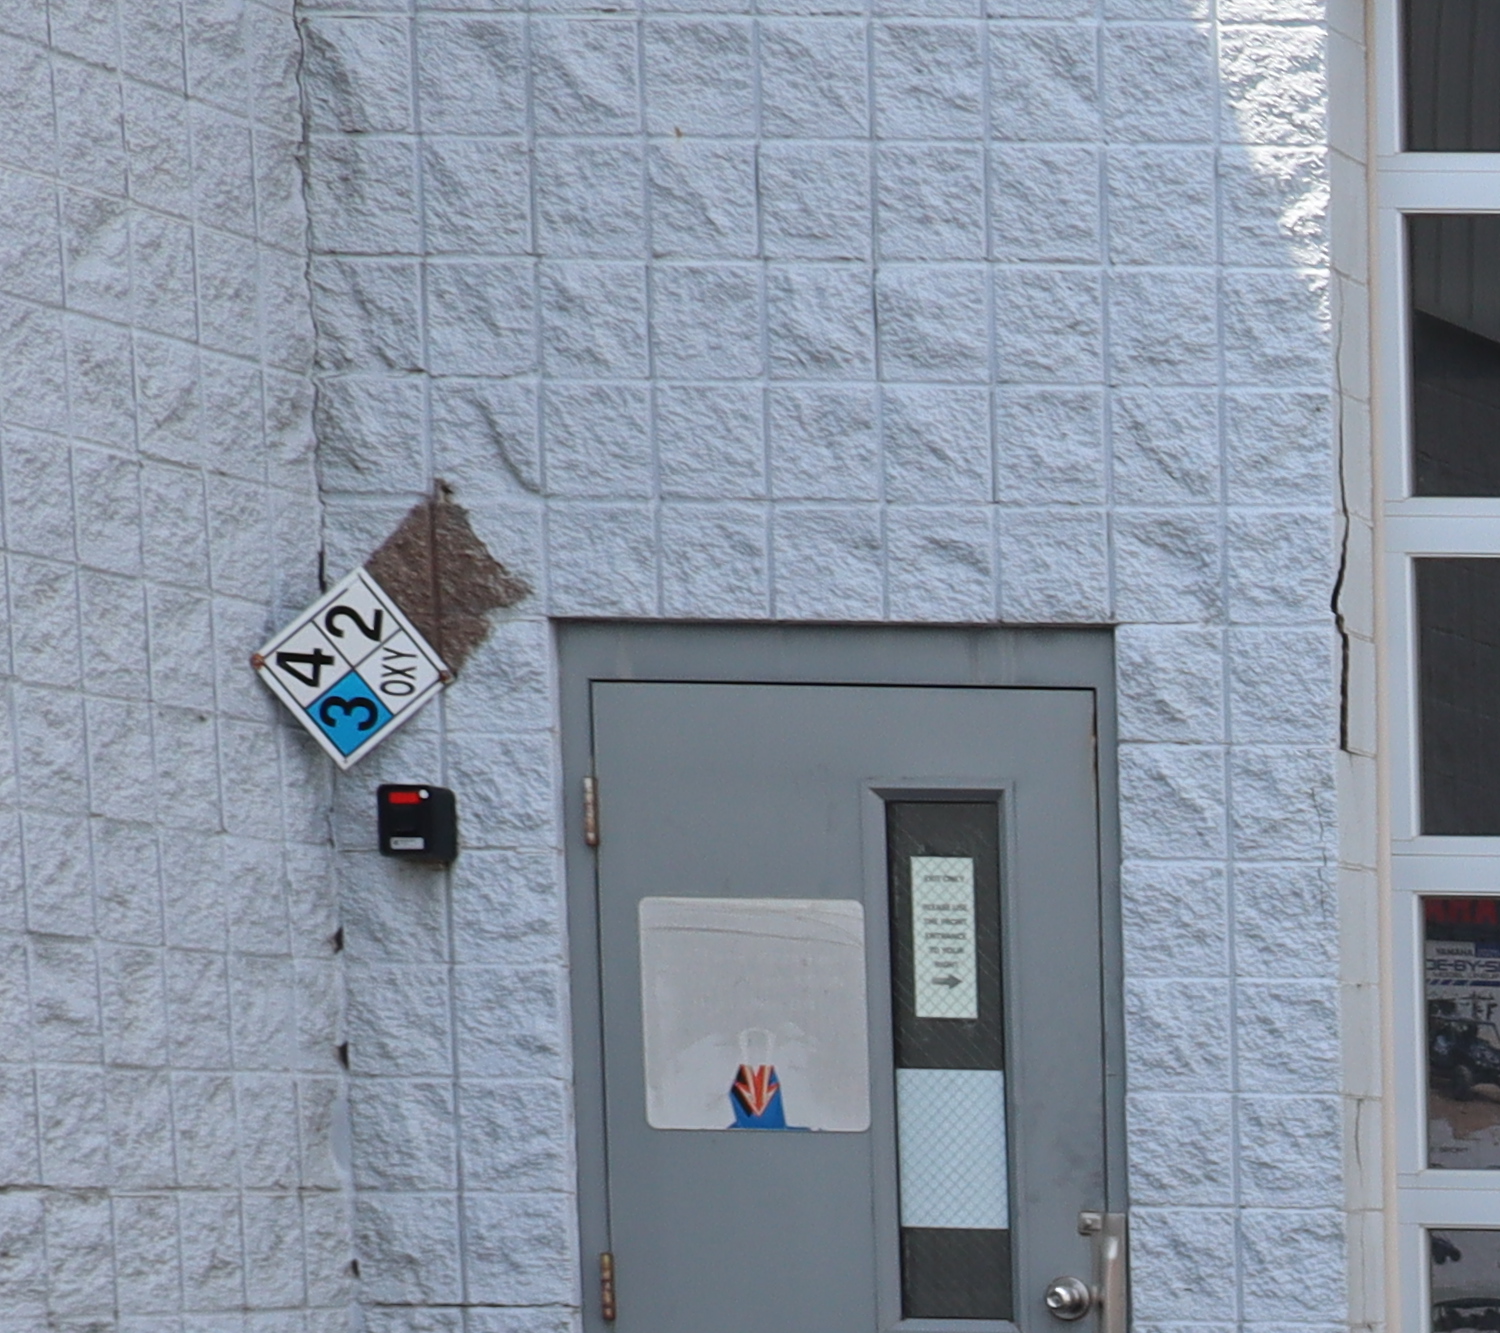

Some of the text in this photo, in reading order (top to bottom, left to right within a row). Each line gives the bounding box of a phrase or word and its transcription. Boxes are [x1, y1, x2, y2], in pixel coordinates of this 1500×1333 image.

[324, 605, 383, 642] 2
[276, 648, 335, 688] 4
[380, 647, 417, 696] OXY
[319, 696, 379, 731] 3
